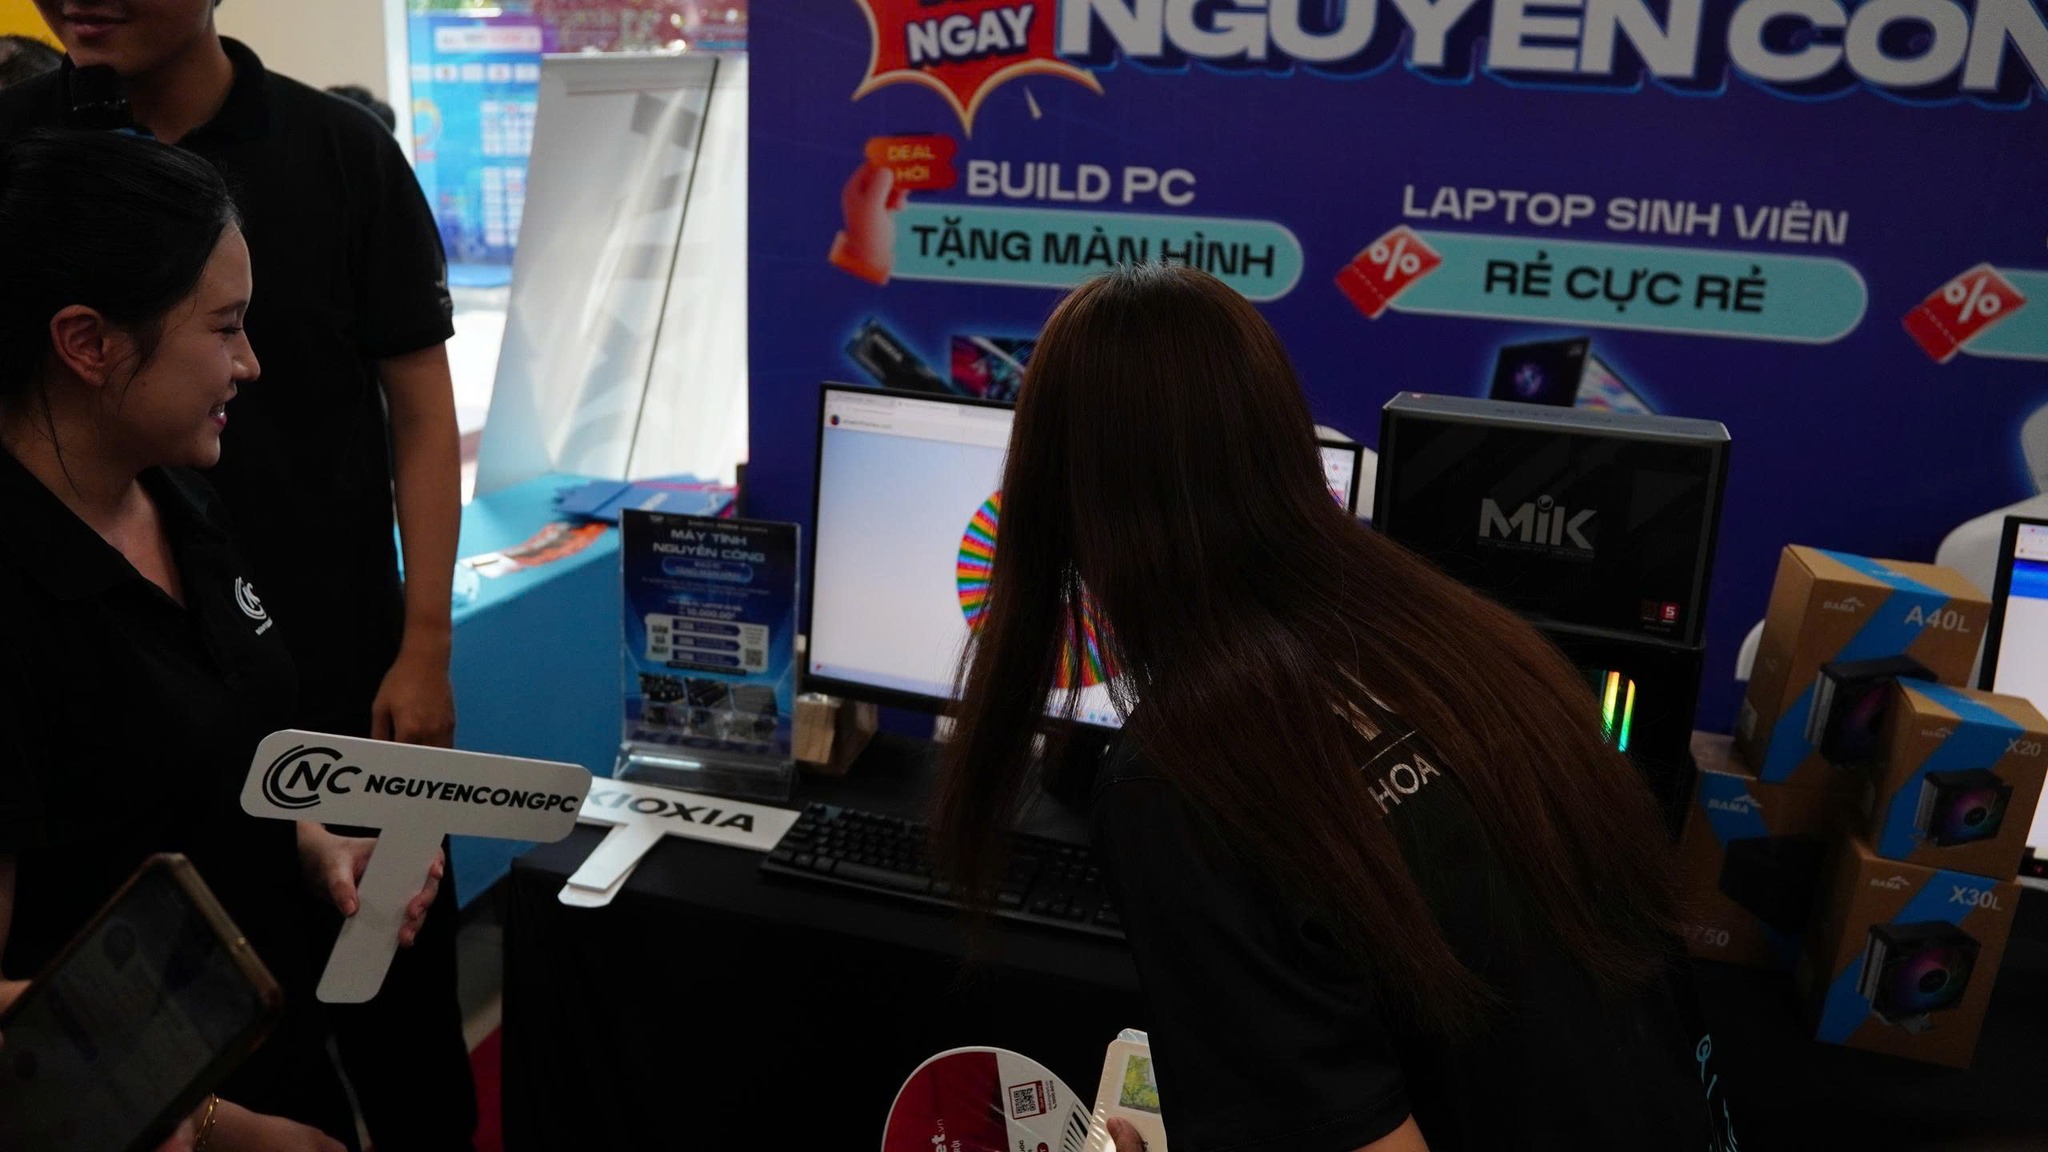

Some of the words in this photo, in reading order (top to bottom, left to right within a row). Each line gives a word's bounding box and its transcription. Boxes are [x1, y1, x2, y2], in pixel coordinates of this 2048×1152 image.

[906, 4, 1033, 62] NGAY
[887, 145, 937, 161] DEAL
[967, 160, 1111, 202] BUILD
[1122, 167, 1196, 205] PC
[1402, 185, 1595, 228] LAPTOP
[1606, 197, 1722, 237] SINH
[1733, 201, 1848, 244] VIÊN
[911, 216, 1031, 268] TẶNG
[1043, 224, 1148, 266] MÀN
[1161, 231, 1275, 278] HÌNH
[1484, 251, 1553, 298] RẺ
[1565, 265, 1683, 313] CỰC
[1694, 265, 1767, 313] RẺ
[1665, 605, 1676, 616] 5
[1903, 604, 1971, 634] A40L
[2004, 737, 2042, 757] X20
[363, 774, 580, 814] NGUYENCONGPC
[1948, 884, 2003, 911] X30L
